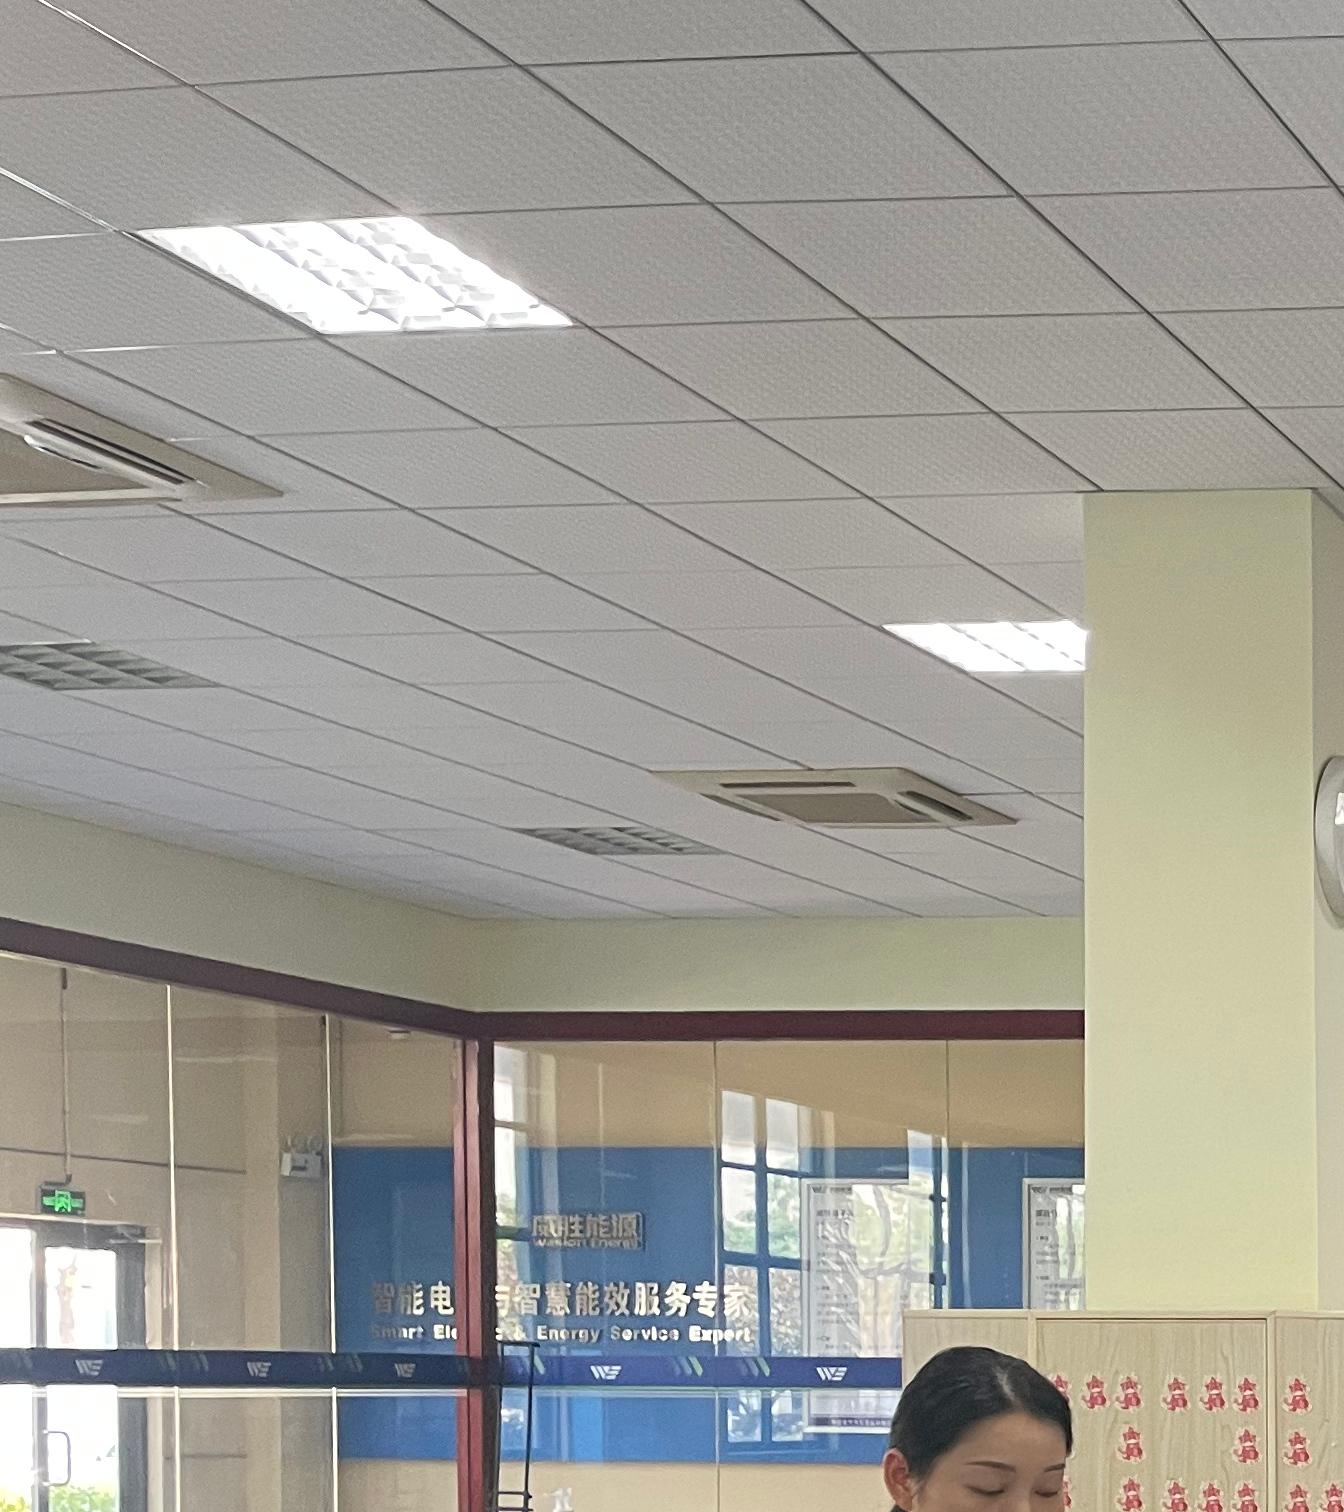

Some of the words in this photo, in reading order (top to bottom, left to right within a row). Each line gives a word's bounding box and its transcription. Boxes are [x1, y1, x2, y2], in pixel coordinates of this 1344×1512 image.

[536, 1324, 600, 1344] Energy
[610, 1325, 680, 1341] Service
[688, 1325, 752, 1345] Expert
